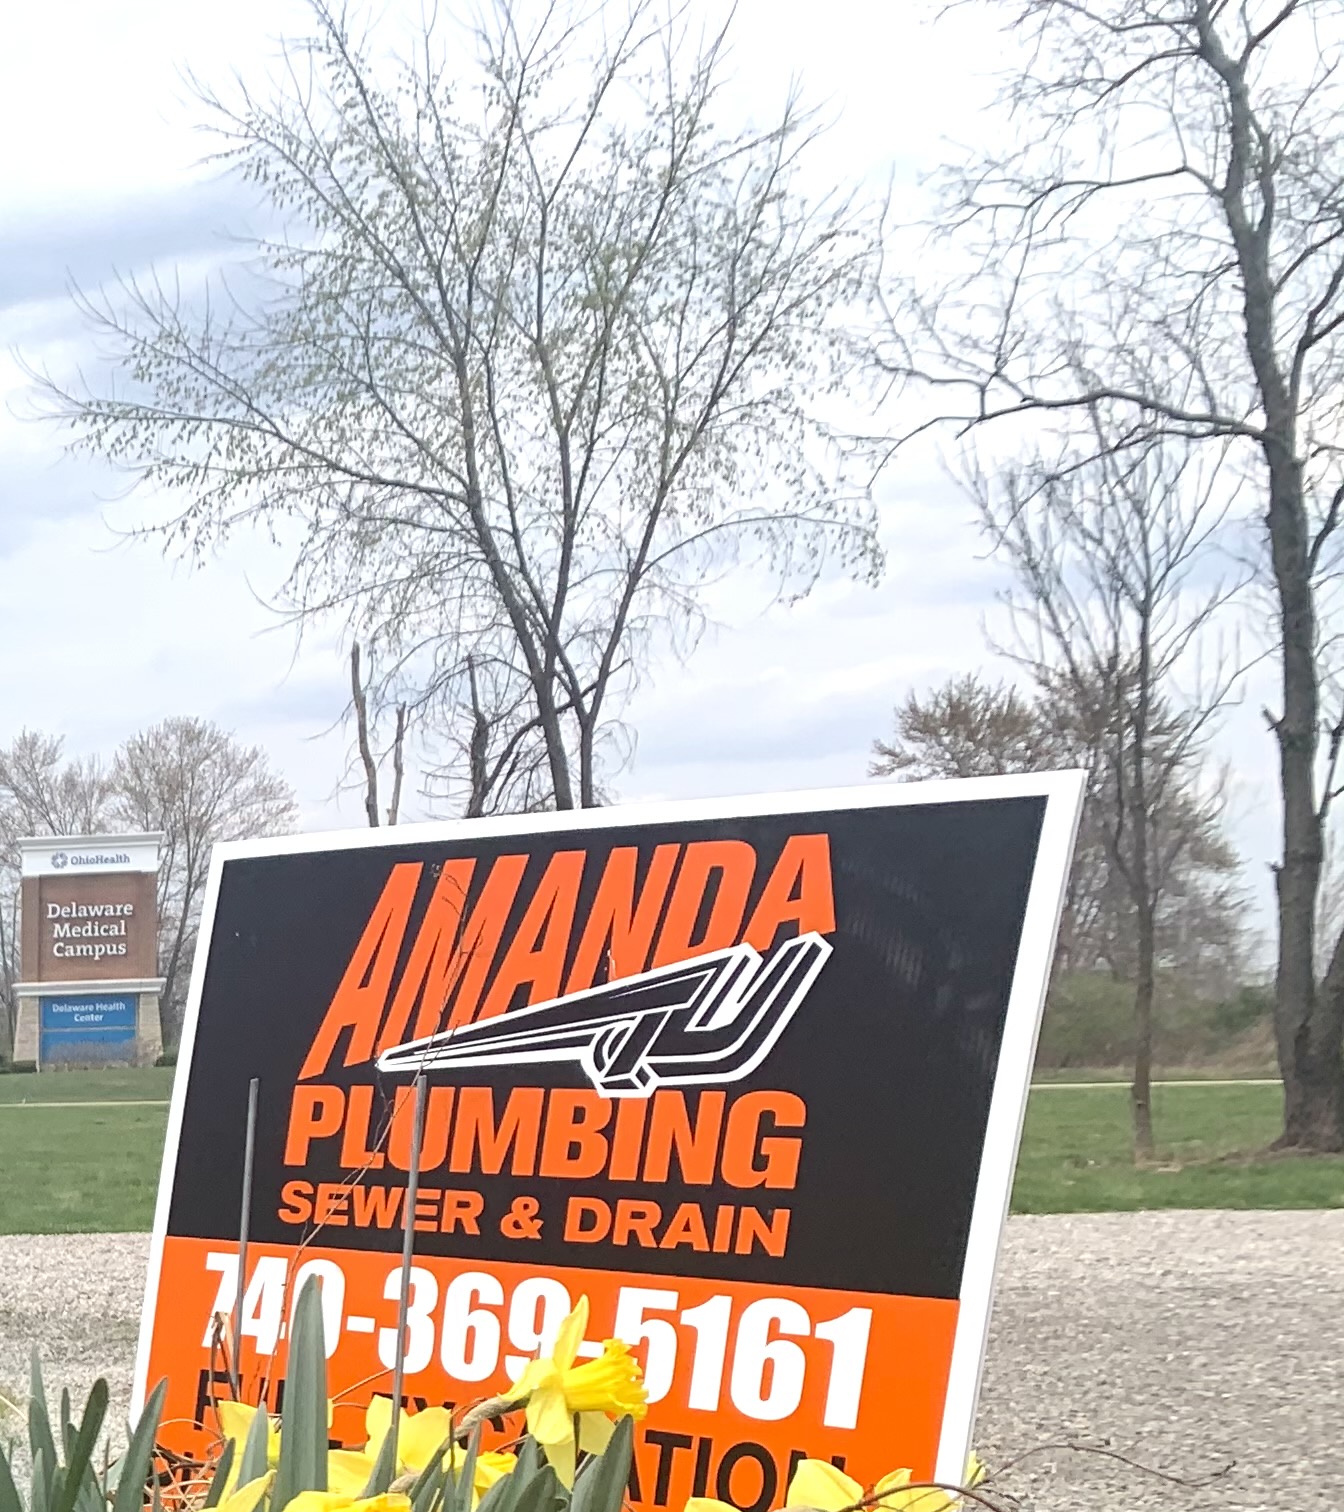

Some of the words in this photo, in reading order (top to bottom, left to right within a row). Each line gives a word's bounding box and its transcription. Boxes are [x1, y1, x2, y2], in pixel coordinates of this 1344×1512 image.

[70, 853, 131, 865] OhioHealth
[47, 902, 134, 919] Delaware
[52, 920, 127, 938] Medical
[52, 942, 127, 960] Campus
[299, 834, 836, 1079] AMANDA
[52, 1003, 94, 1013] Delaware
[96, 1001, 126, 1011] Health
[74, 1013, 104, 1022] Center
[284, 1084, 807, 1190] PLUMBING
[278, 1181, 485, 1236] SEWER
[500, 1196, 544, 1240] &
[563, 1198, 791, 1258] DRAIN
[201, 1252, 873, 1430] 740-369-5161
